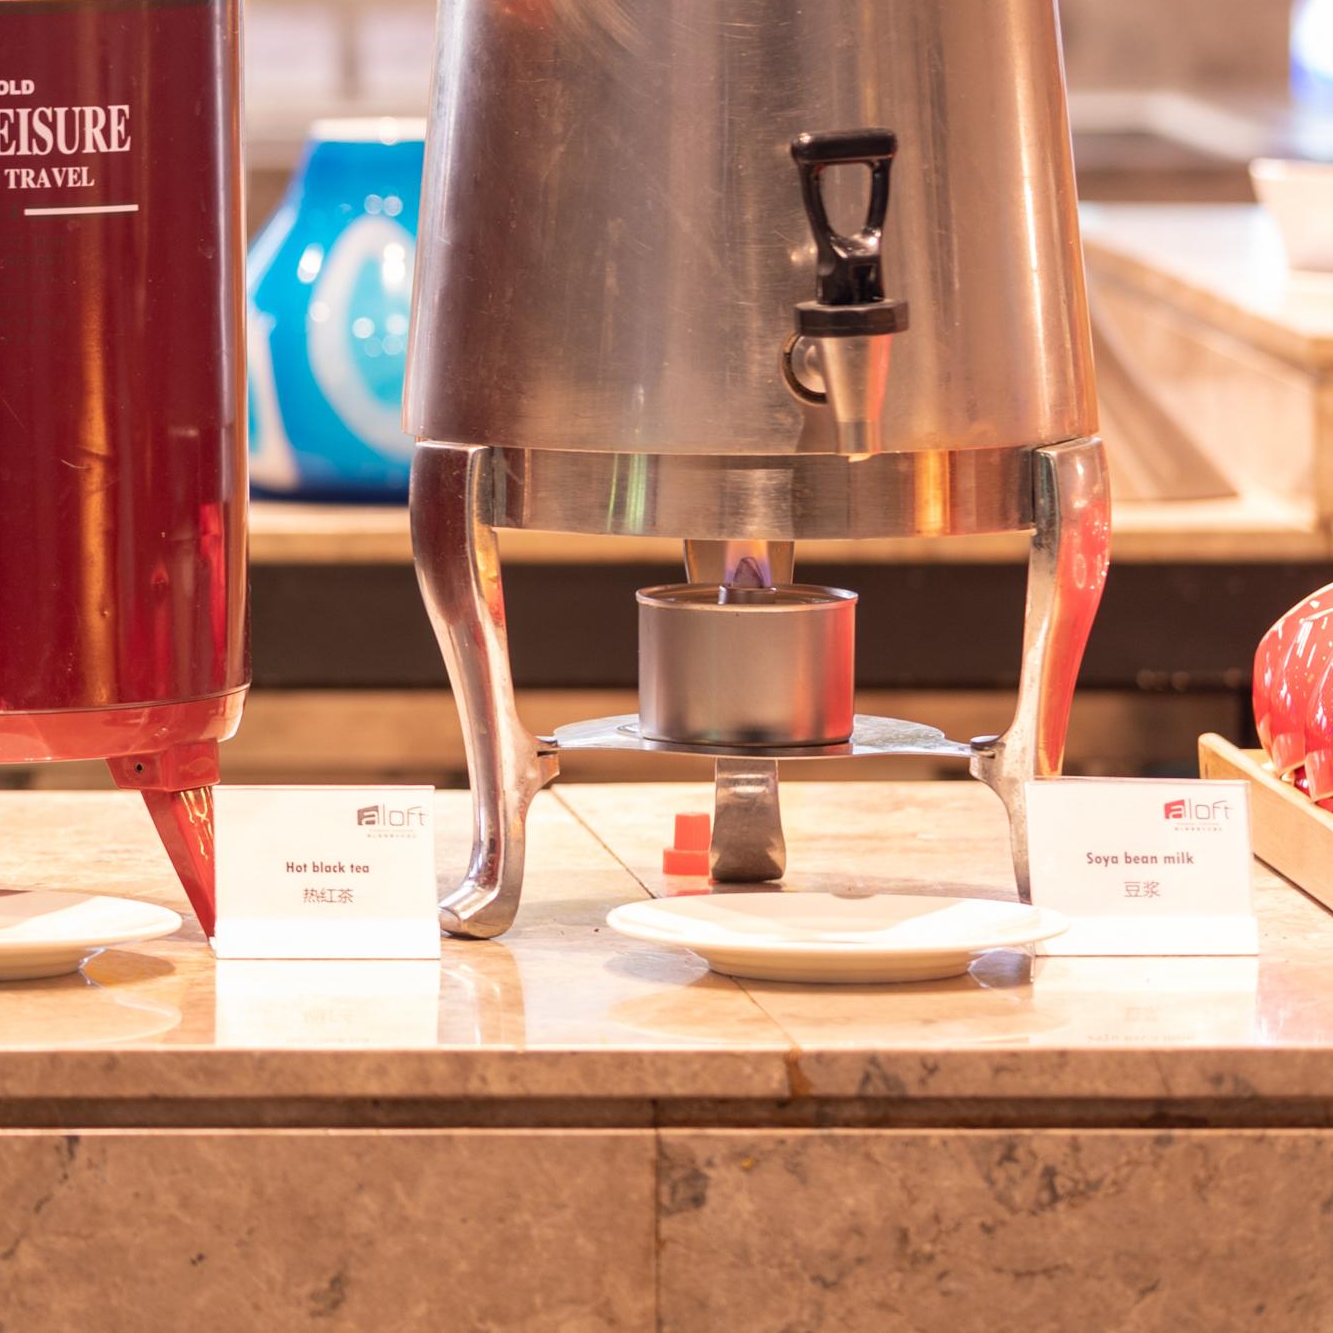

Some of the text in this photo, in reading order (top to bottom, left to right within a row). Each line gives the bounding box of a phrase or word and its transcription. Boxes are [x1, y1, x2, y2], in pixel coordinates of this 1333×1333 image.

[4, 166, 95, 189] TRAVEL
[357, 804, 427, 826] aloft
[1164, 798, 1233, 820] aloft
[286, 861, 370, 874] Hot black tea
[1086, 852, 1195, 867] Soya bean milk
[1124, 881, 1161, 898] 豆浆
